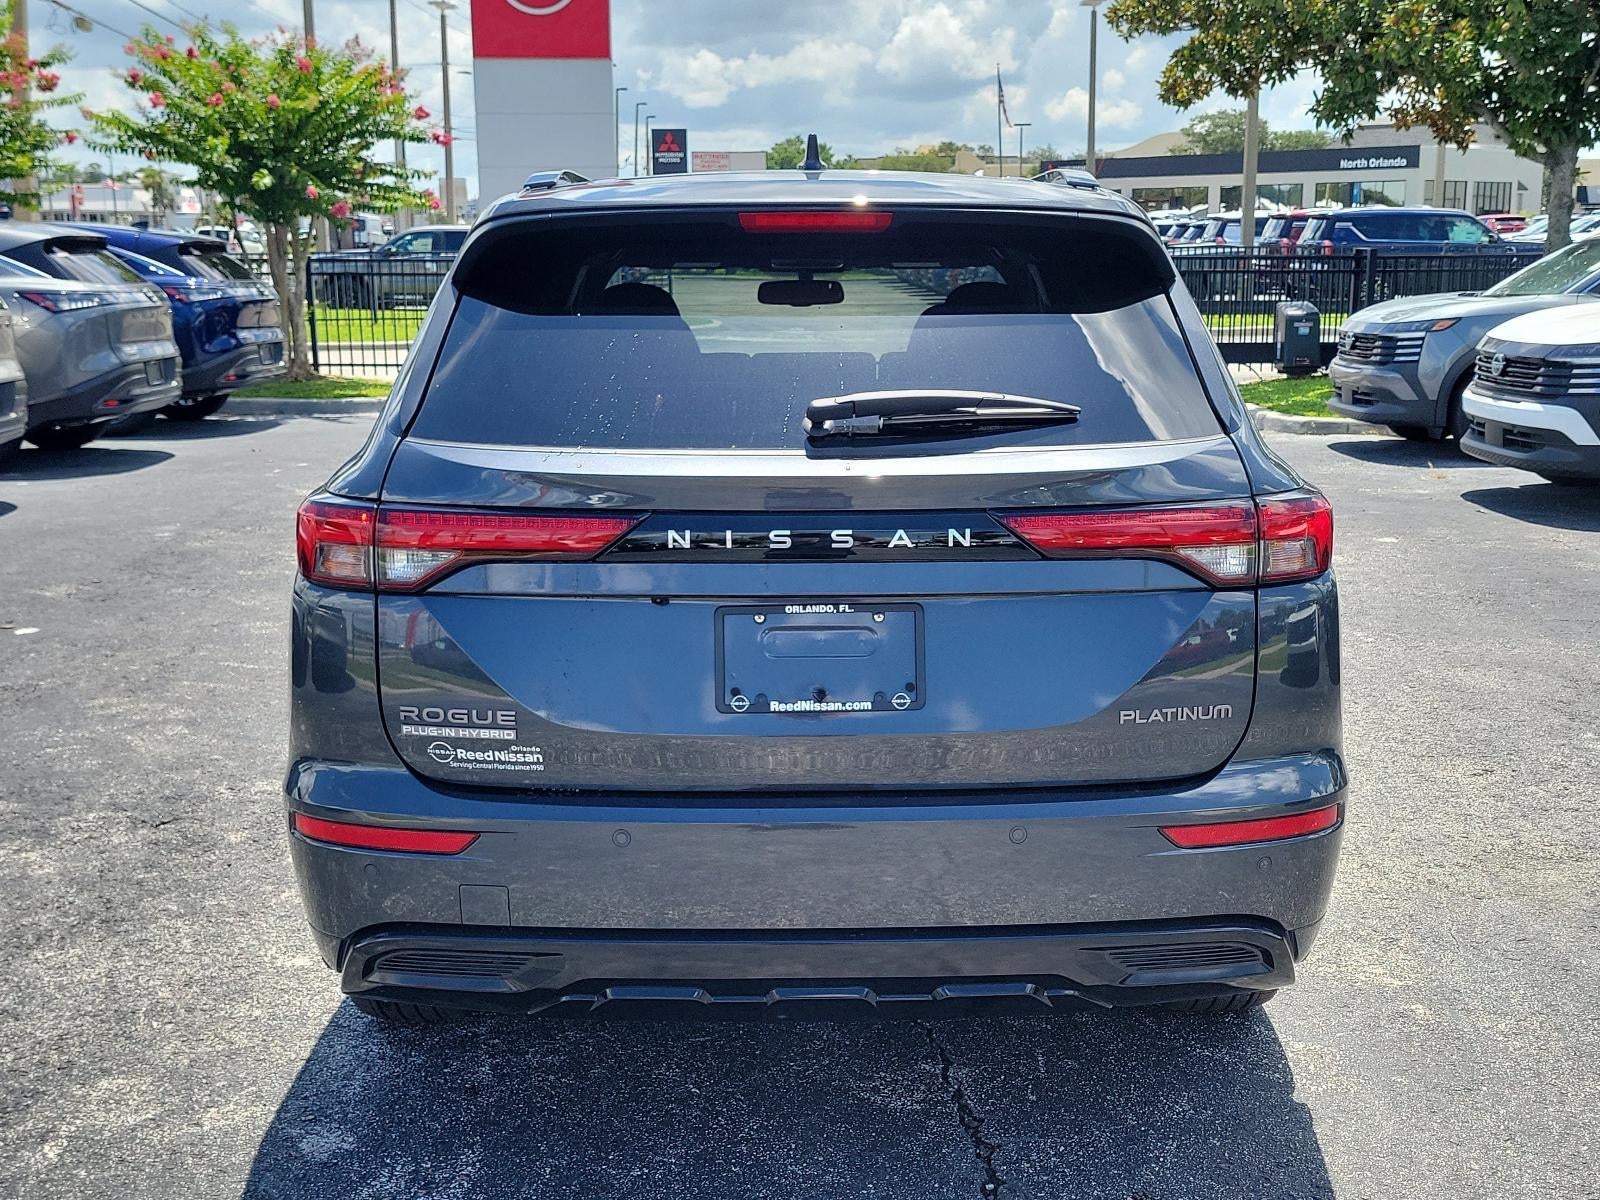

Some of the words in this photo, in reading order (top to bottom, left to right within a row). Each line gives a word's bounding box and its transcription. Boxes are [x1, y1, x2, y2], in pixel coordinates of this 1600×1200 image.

[1340, 158, 1367, 168] North
[1369, 157, 1407, 168] Orlando
[667, 528, 971, 549] NISSAN
[785, 605, 837, 614] ORLANDO,
[839, 604, 854, 613] FL.
[770, 701, 872, 712] ReedNissan.com
[400, 706, 516, 725] ROGUE
[1119, 704, 1232, 725] PLATINUM
[402, 725, 455, 737] PLUG-IN
[459, 728, 515, 740] HYBRID
[449, 761, 473, 769] Serving
